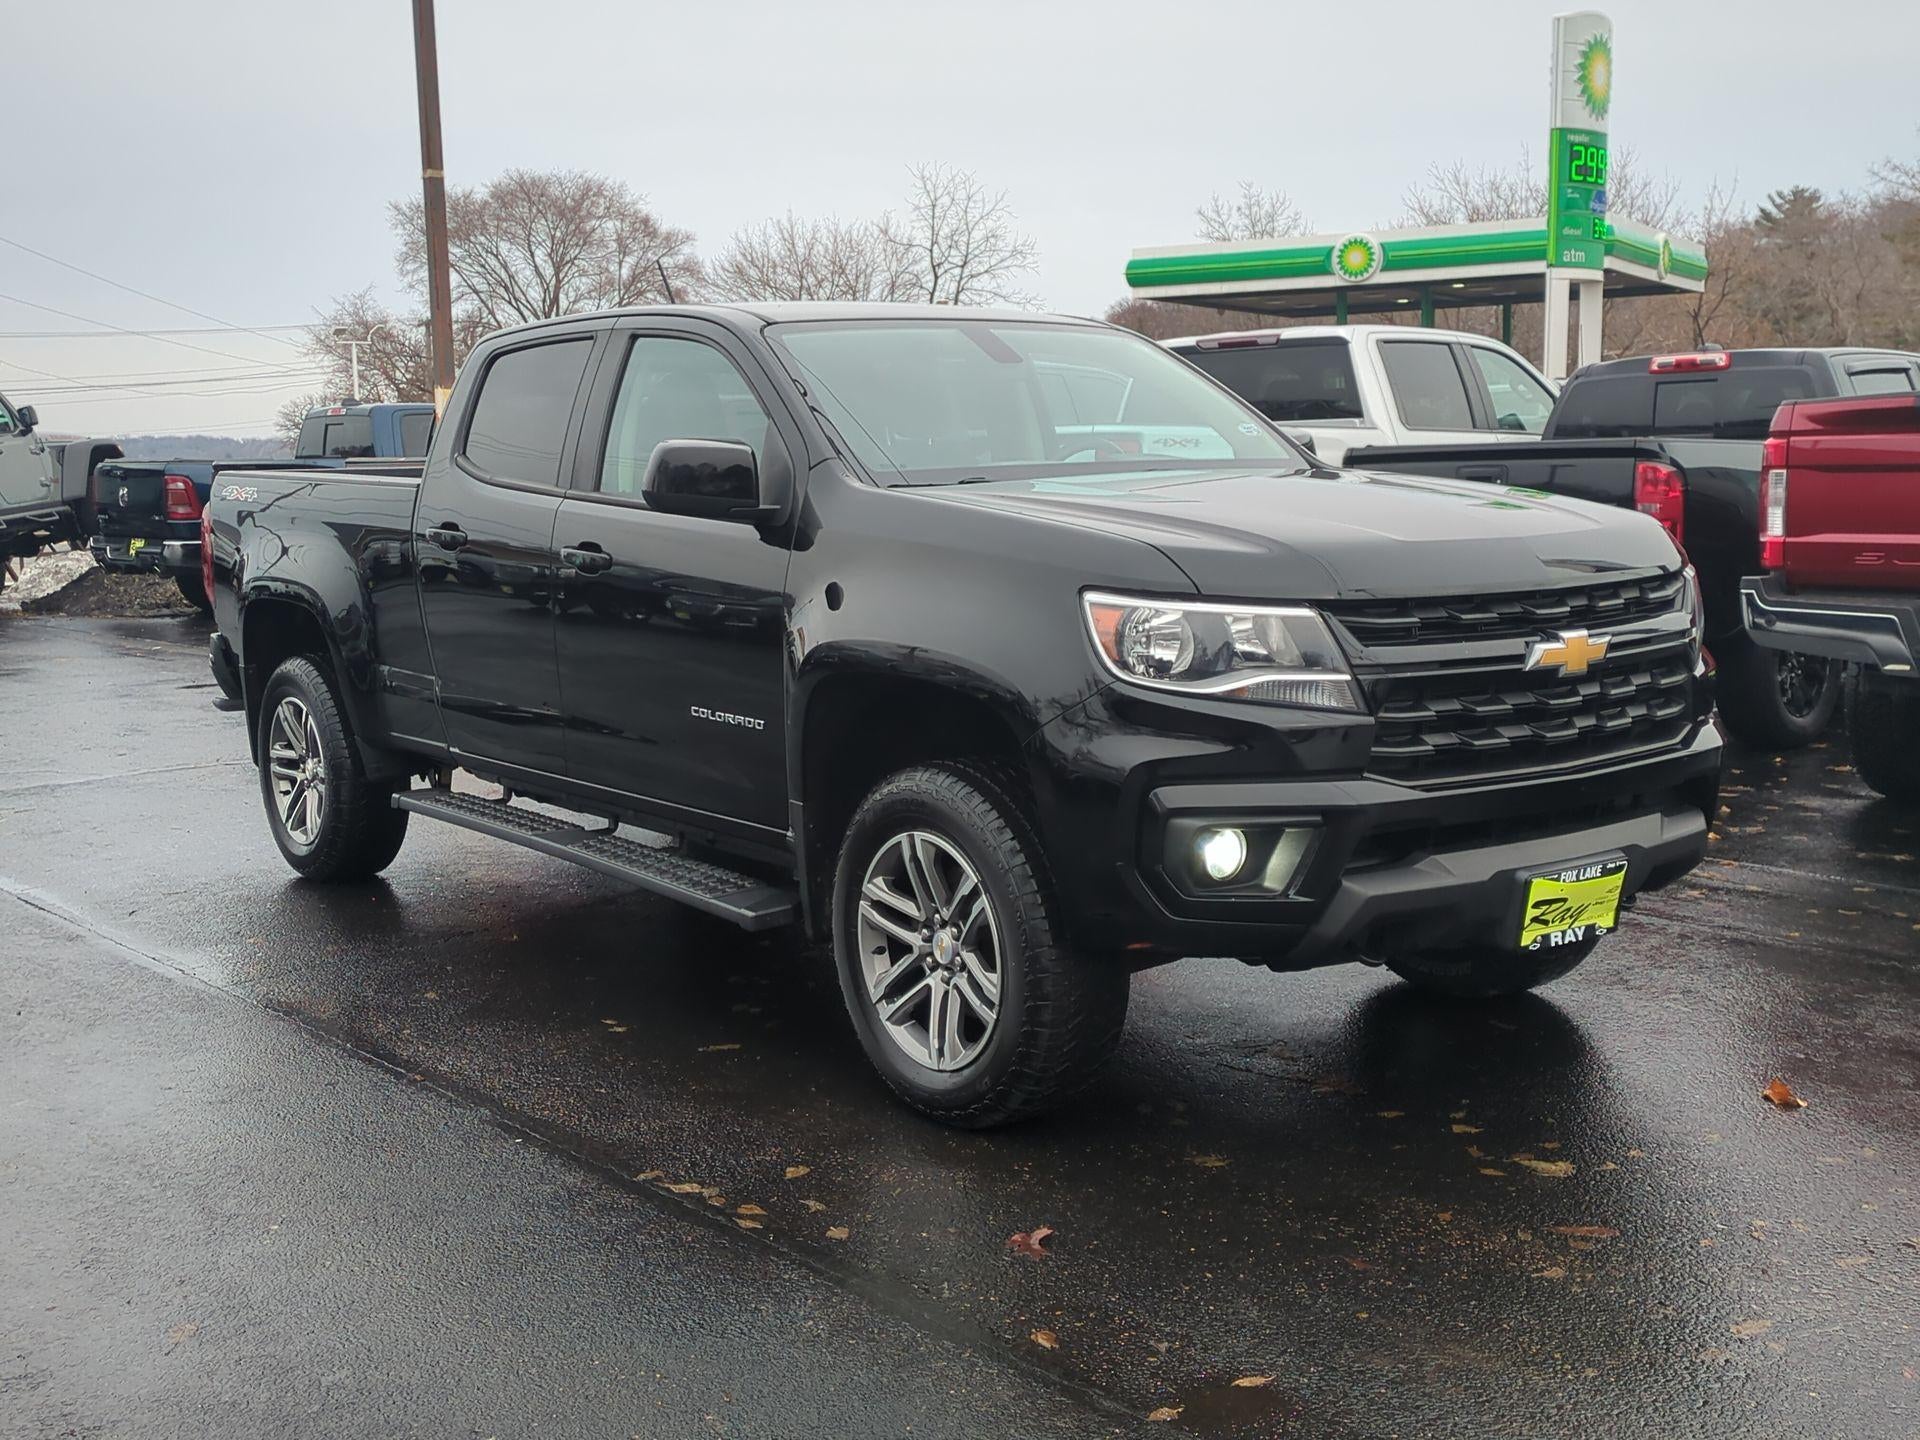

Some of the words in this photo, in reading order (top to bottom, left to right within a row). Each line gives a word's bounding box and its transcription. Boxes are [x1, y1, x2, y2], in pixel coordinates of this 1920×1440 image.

[1563, 248, 1586, 262] atm
[691, 706, 765, 730] COLORADO
[1560, 869, 1579, 883] FOX
[1580, 864, 1603, 881] LAKE
[1523, 897, 1592, 930] Ray
[1550, 926, 1586, 947] RAY
